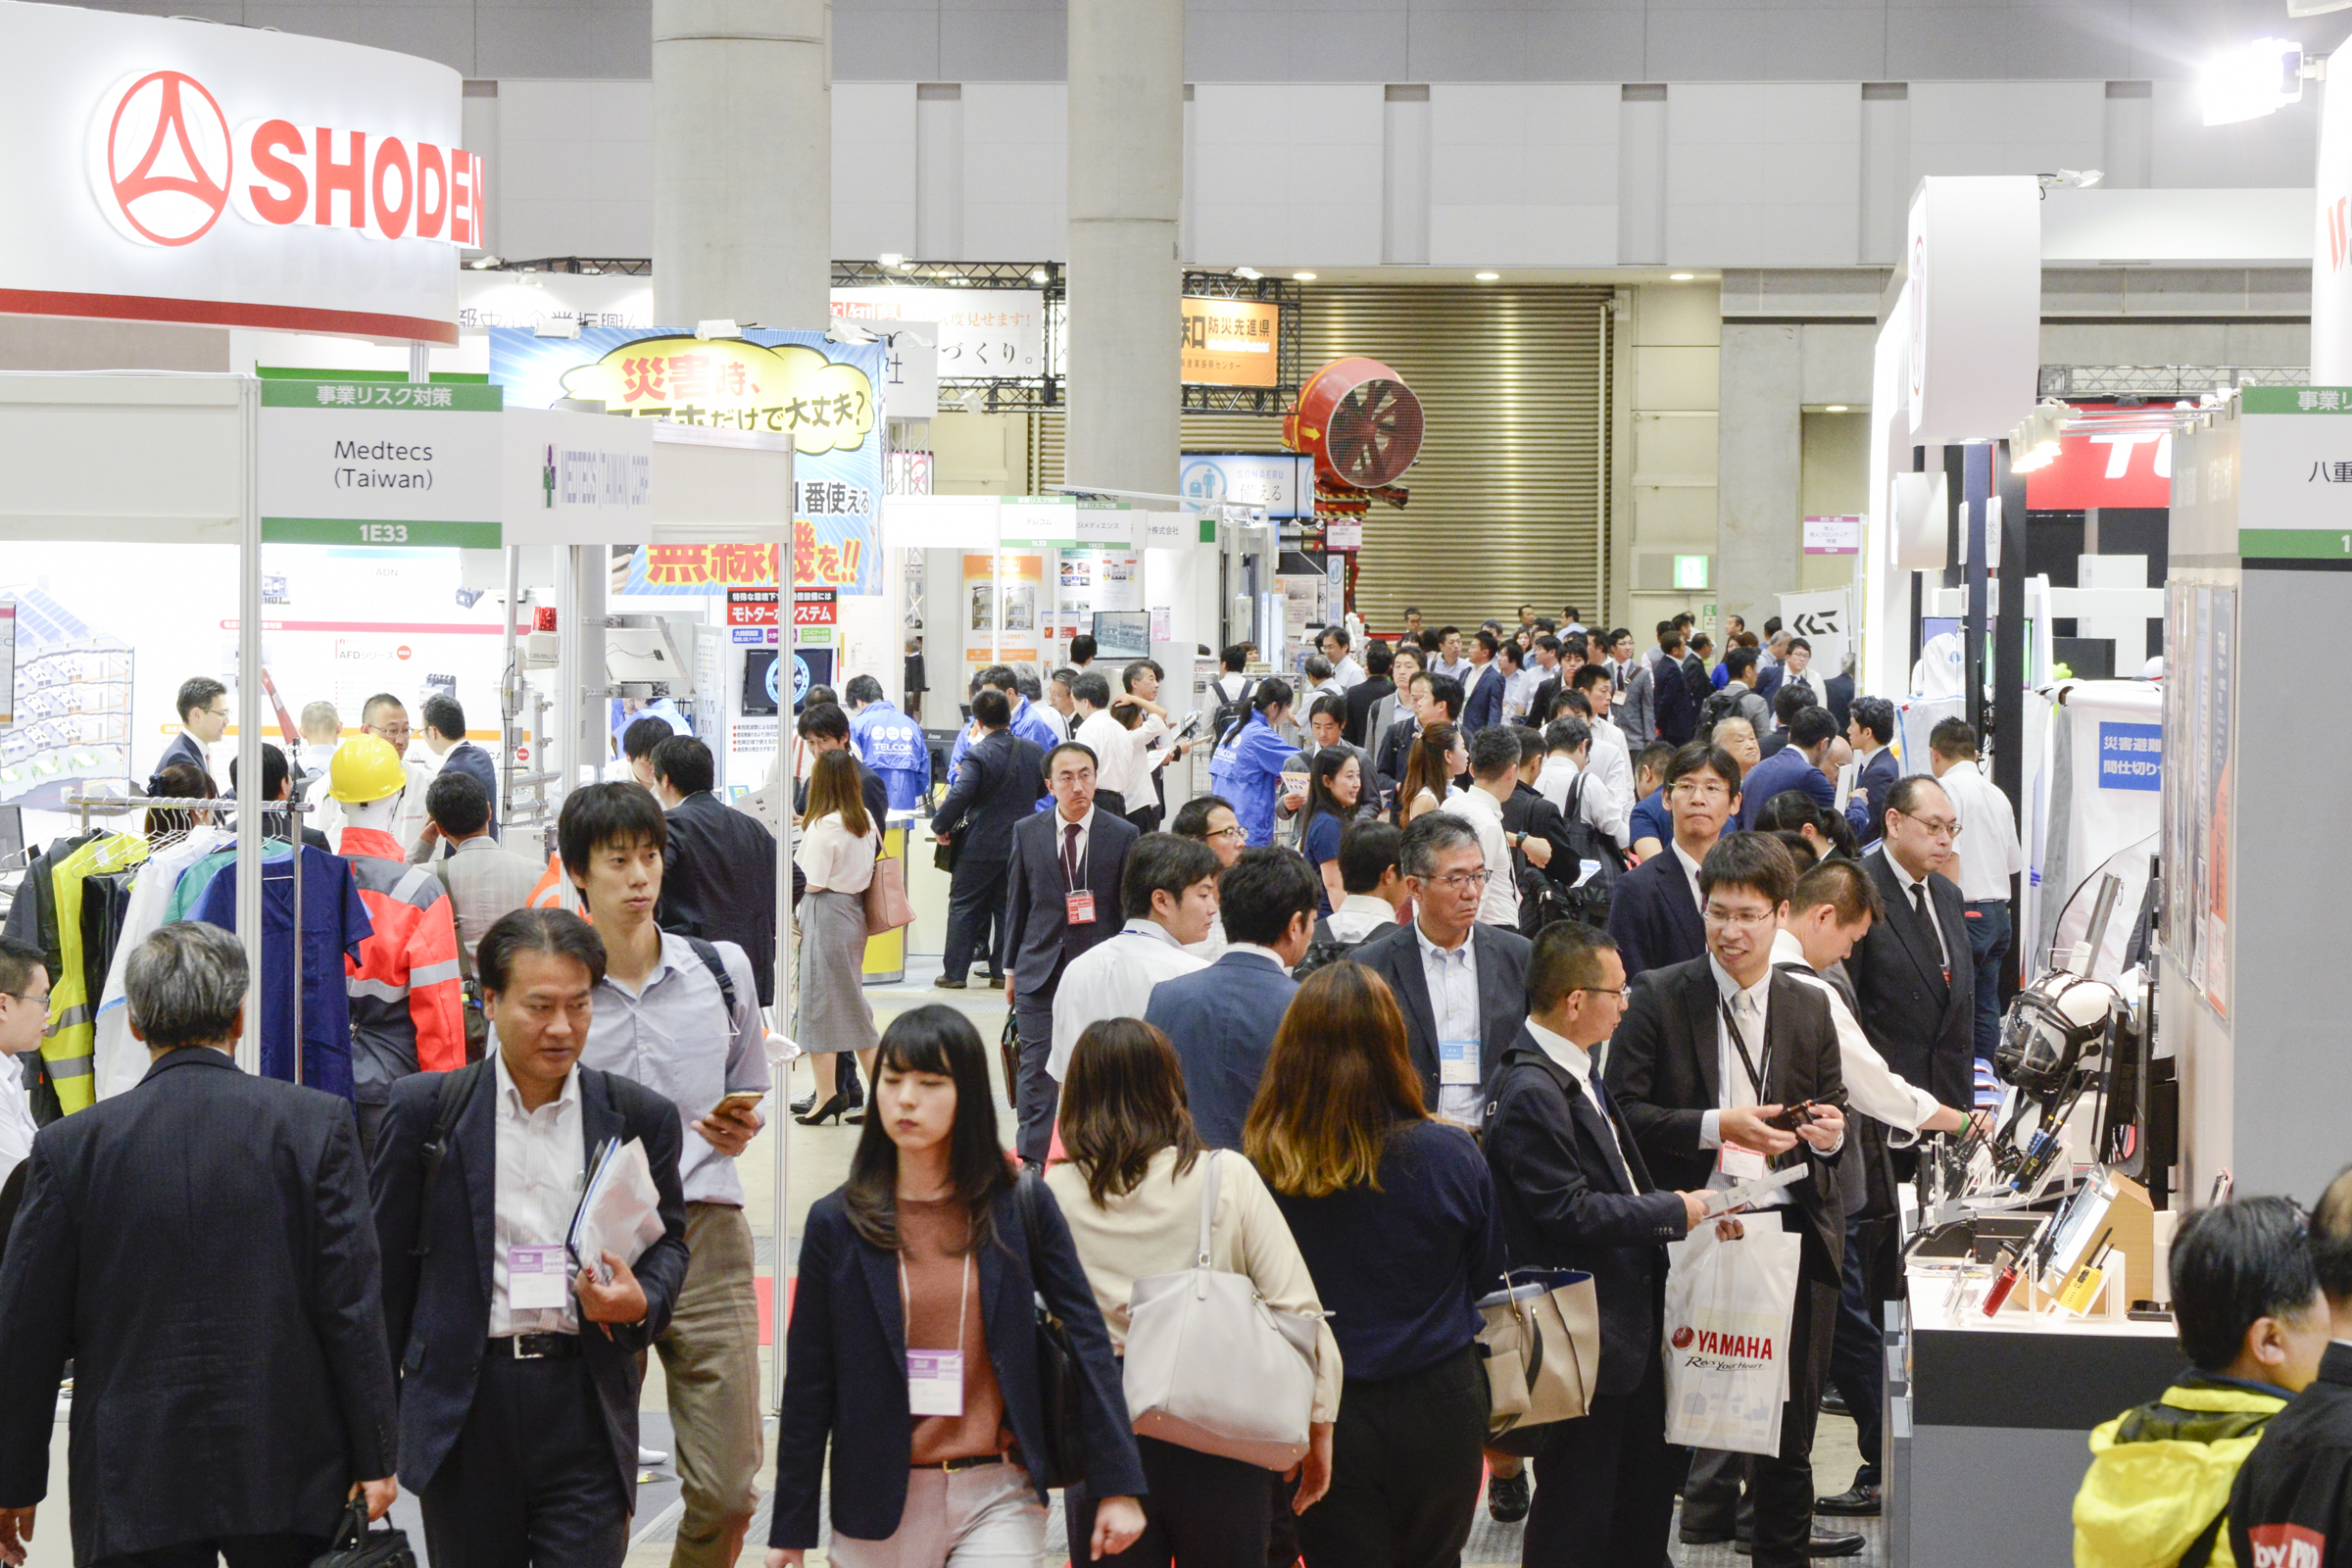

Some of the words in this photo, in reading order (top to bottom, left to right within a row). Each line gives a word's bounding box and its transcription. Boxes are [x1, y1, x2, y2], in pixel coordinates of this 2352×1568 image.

[249, 119, 485, 250] SHODEN
[1208, 316, 1270, 337] 防災先進県
[621, 354, 760, 403] 災害時、
[317, 385, 453, 408] 事業リスク対策
[334, 440, 433, 462] Medtecs
[333, 466, 433, 491] (Taiwan)
[561, 451, 597, 505] MEDTECS
[1237, 469, 1284, 480] SONAERU
[360, 524, 409, 543] 1E33
[732, 606, 832, 622] モトターステム
[2103, 736, 2162, 753] 災害避難
[2103, 760, 2162, 776] 間仕切り
[1698, 1329, 1772, 1360] YAMAHA
